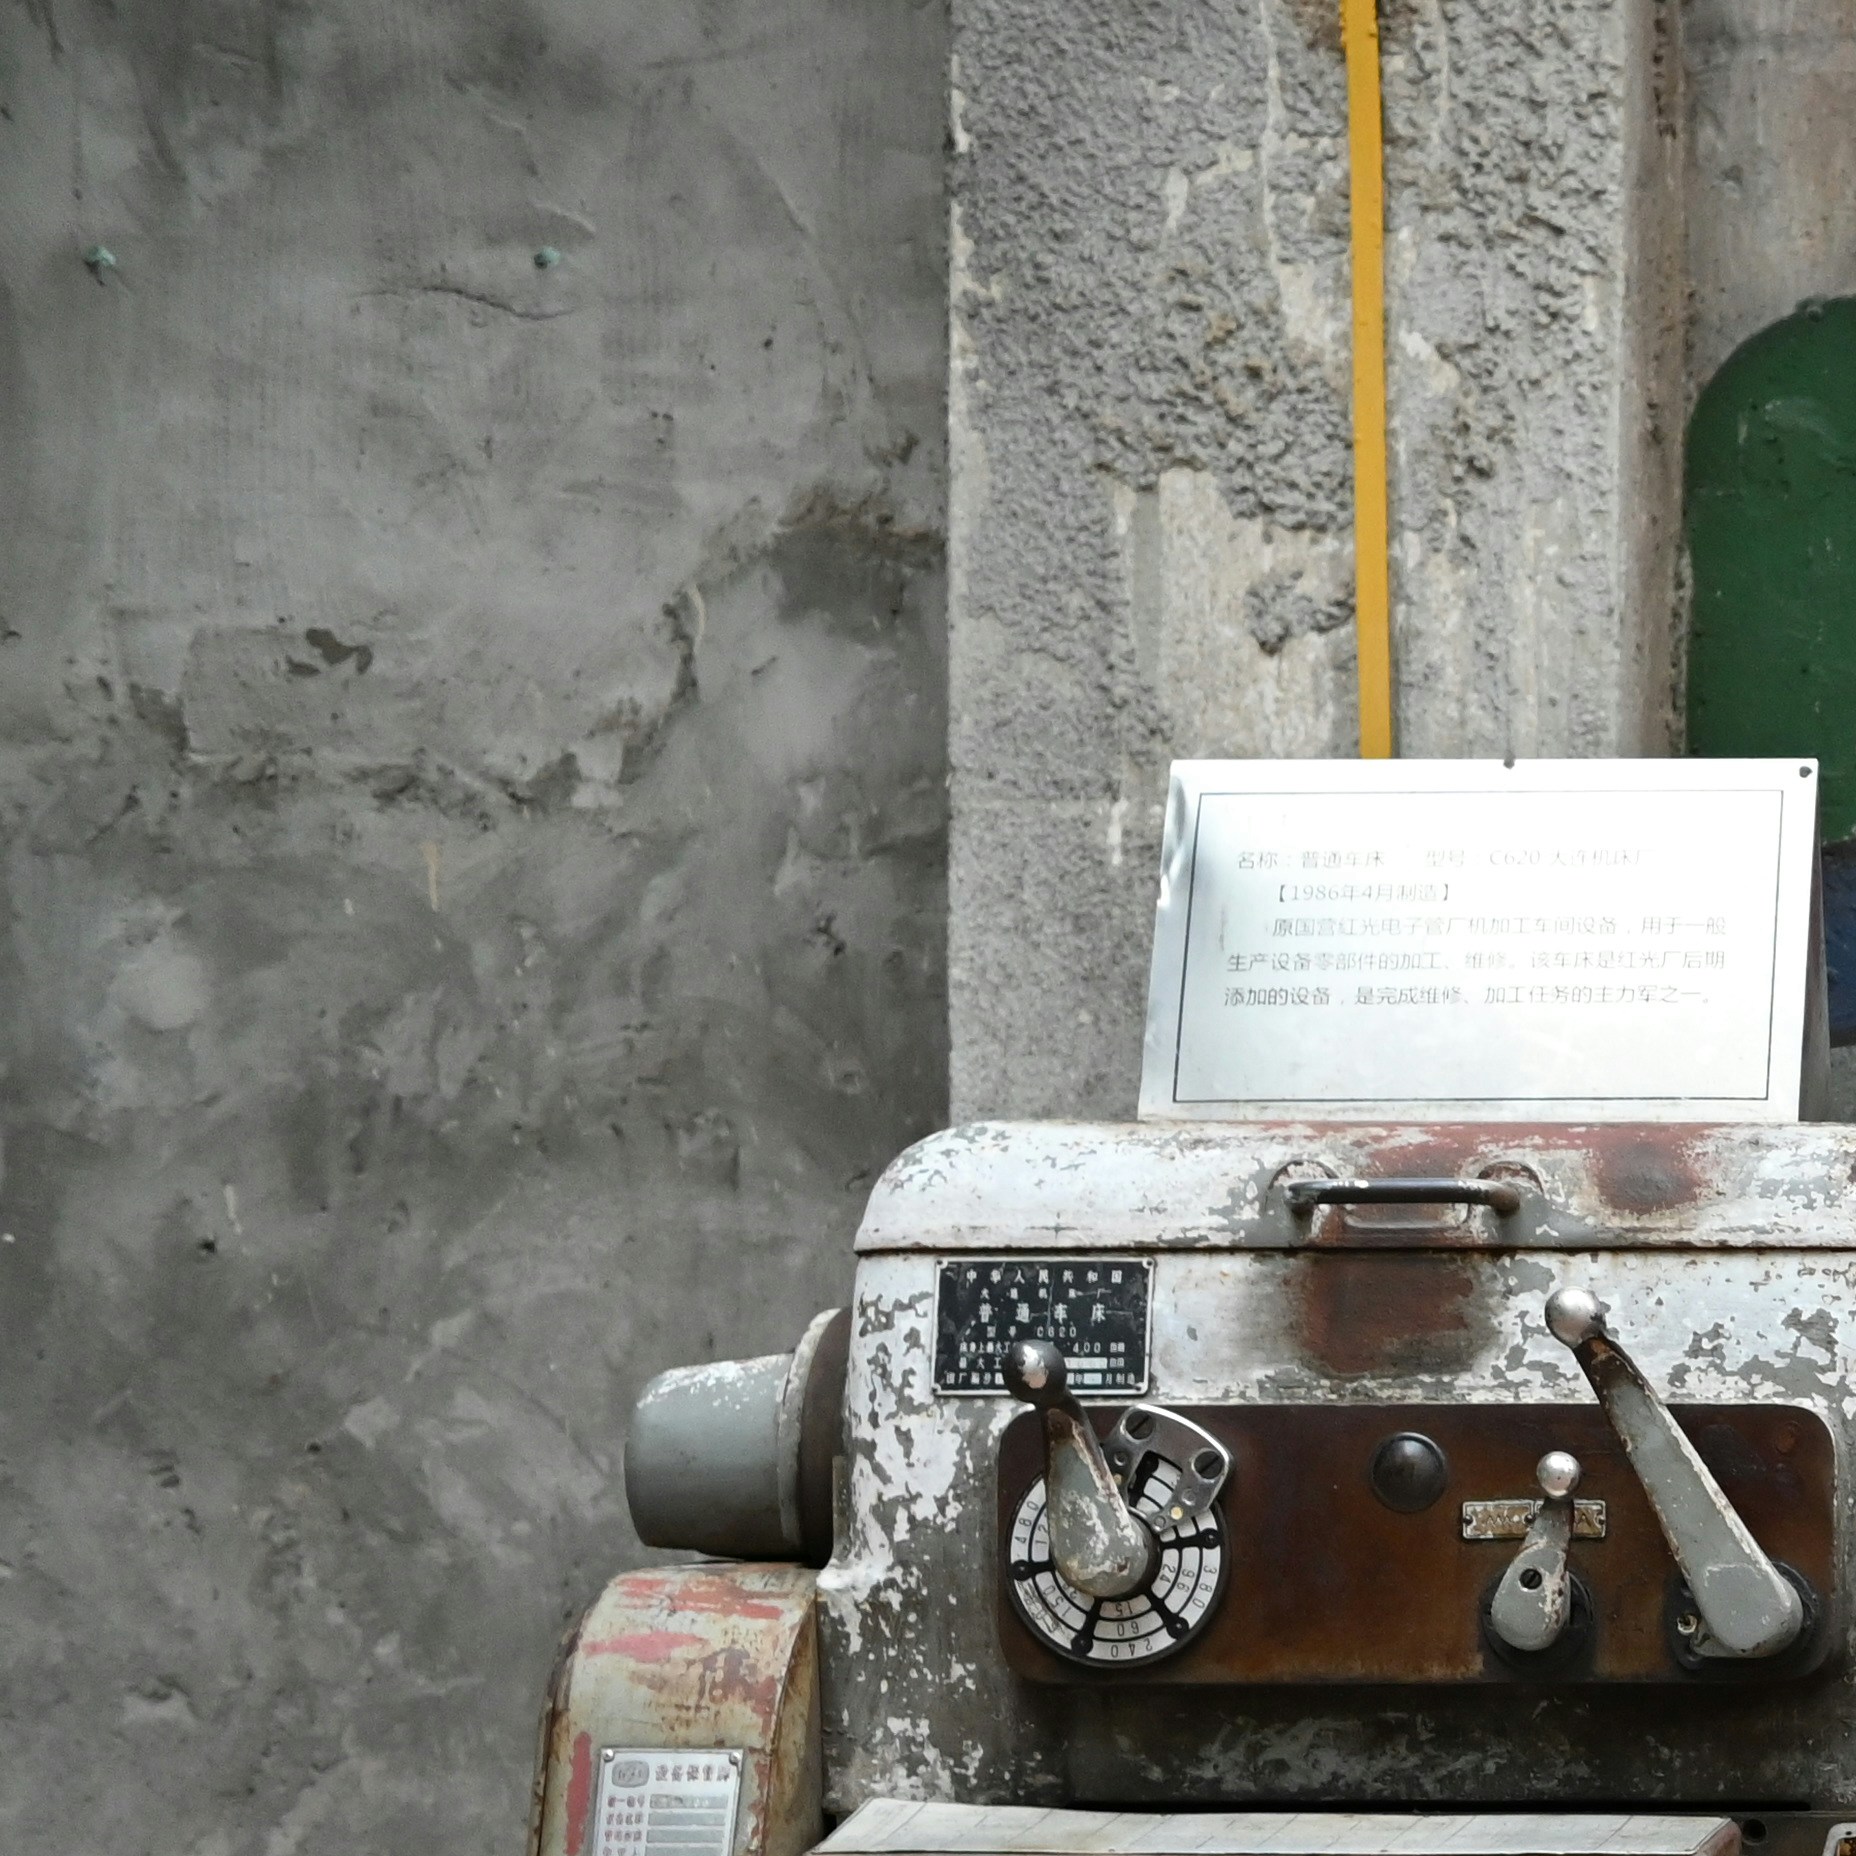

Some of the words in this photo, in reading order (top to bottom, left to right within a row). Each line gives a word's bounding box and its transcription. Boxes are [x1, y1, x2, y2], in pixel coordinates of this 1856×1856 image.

[1036, 1325, 1078, 1339] C620
[1072, 1342, 1102, 1354] 400
[1018, 1501, 1039, 1544] 480
[1158, 1563, 1177, 1583] 24
[1176, 1568, 1195, 1592] 96
[1192, 1565, 1218, 1609] 380
[1042, 1585, 1072, 1618] 150
[1113, 1600, 1134, 1615] 15
[1116, 1621, 1140, 1638] 60
[1110, 1637, 1154, 1659] 240
